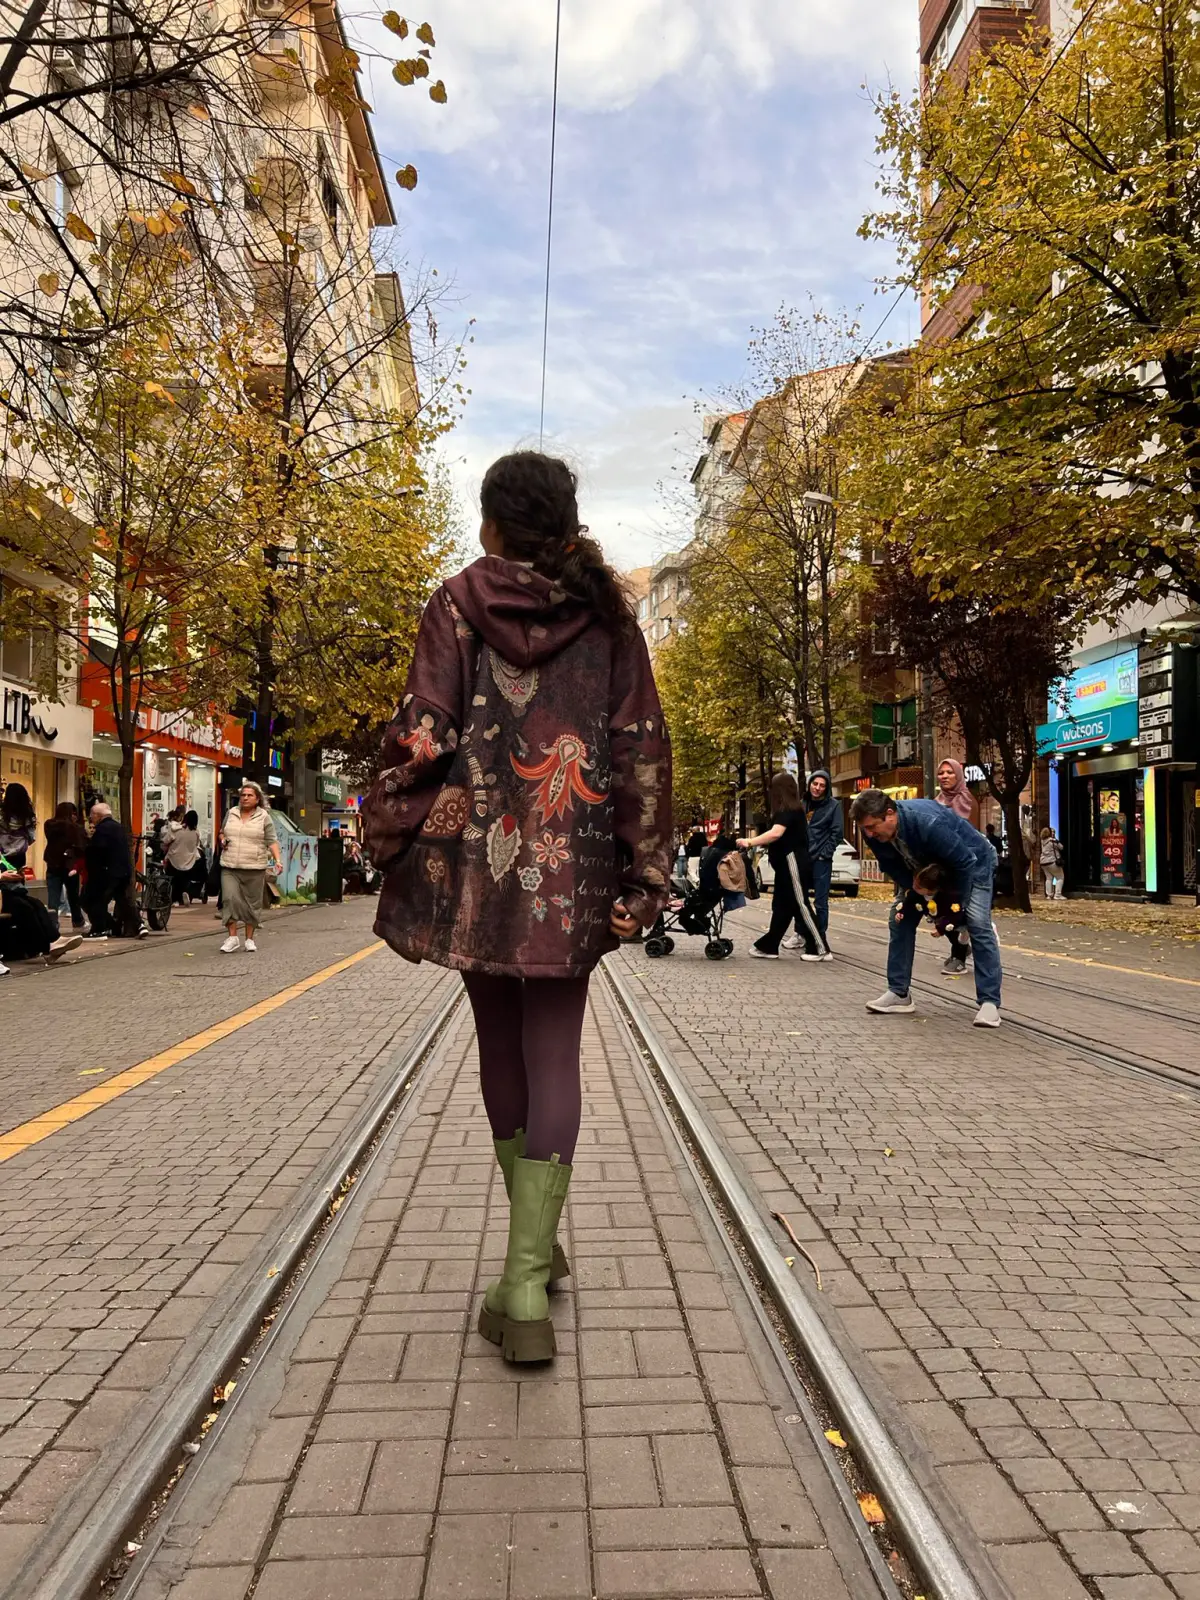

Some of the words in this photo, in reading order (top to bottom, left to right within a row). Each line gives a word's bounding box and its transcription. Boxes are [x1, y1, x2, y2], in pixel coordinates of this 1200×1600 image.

[4, 687, 31, 735] LTB
[1062, 720, 1104, 742] watsons
[10, 757, 32, 776] LTB
